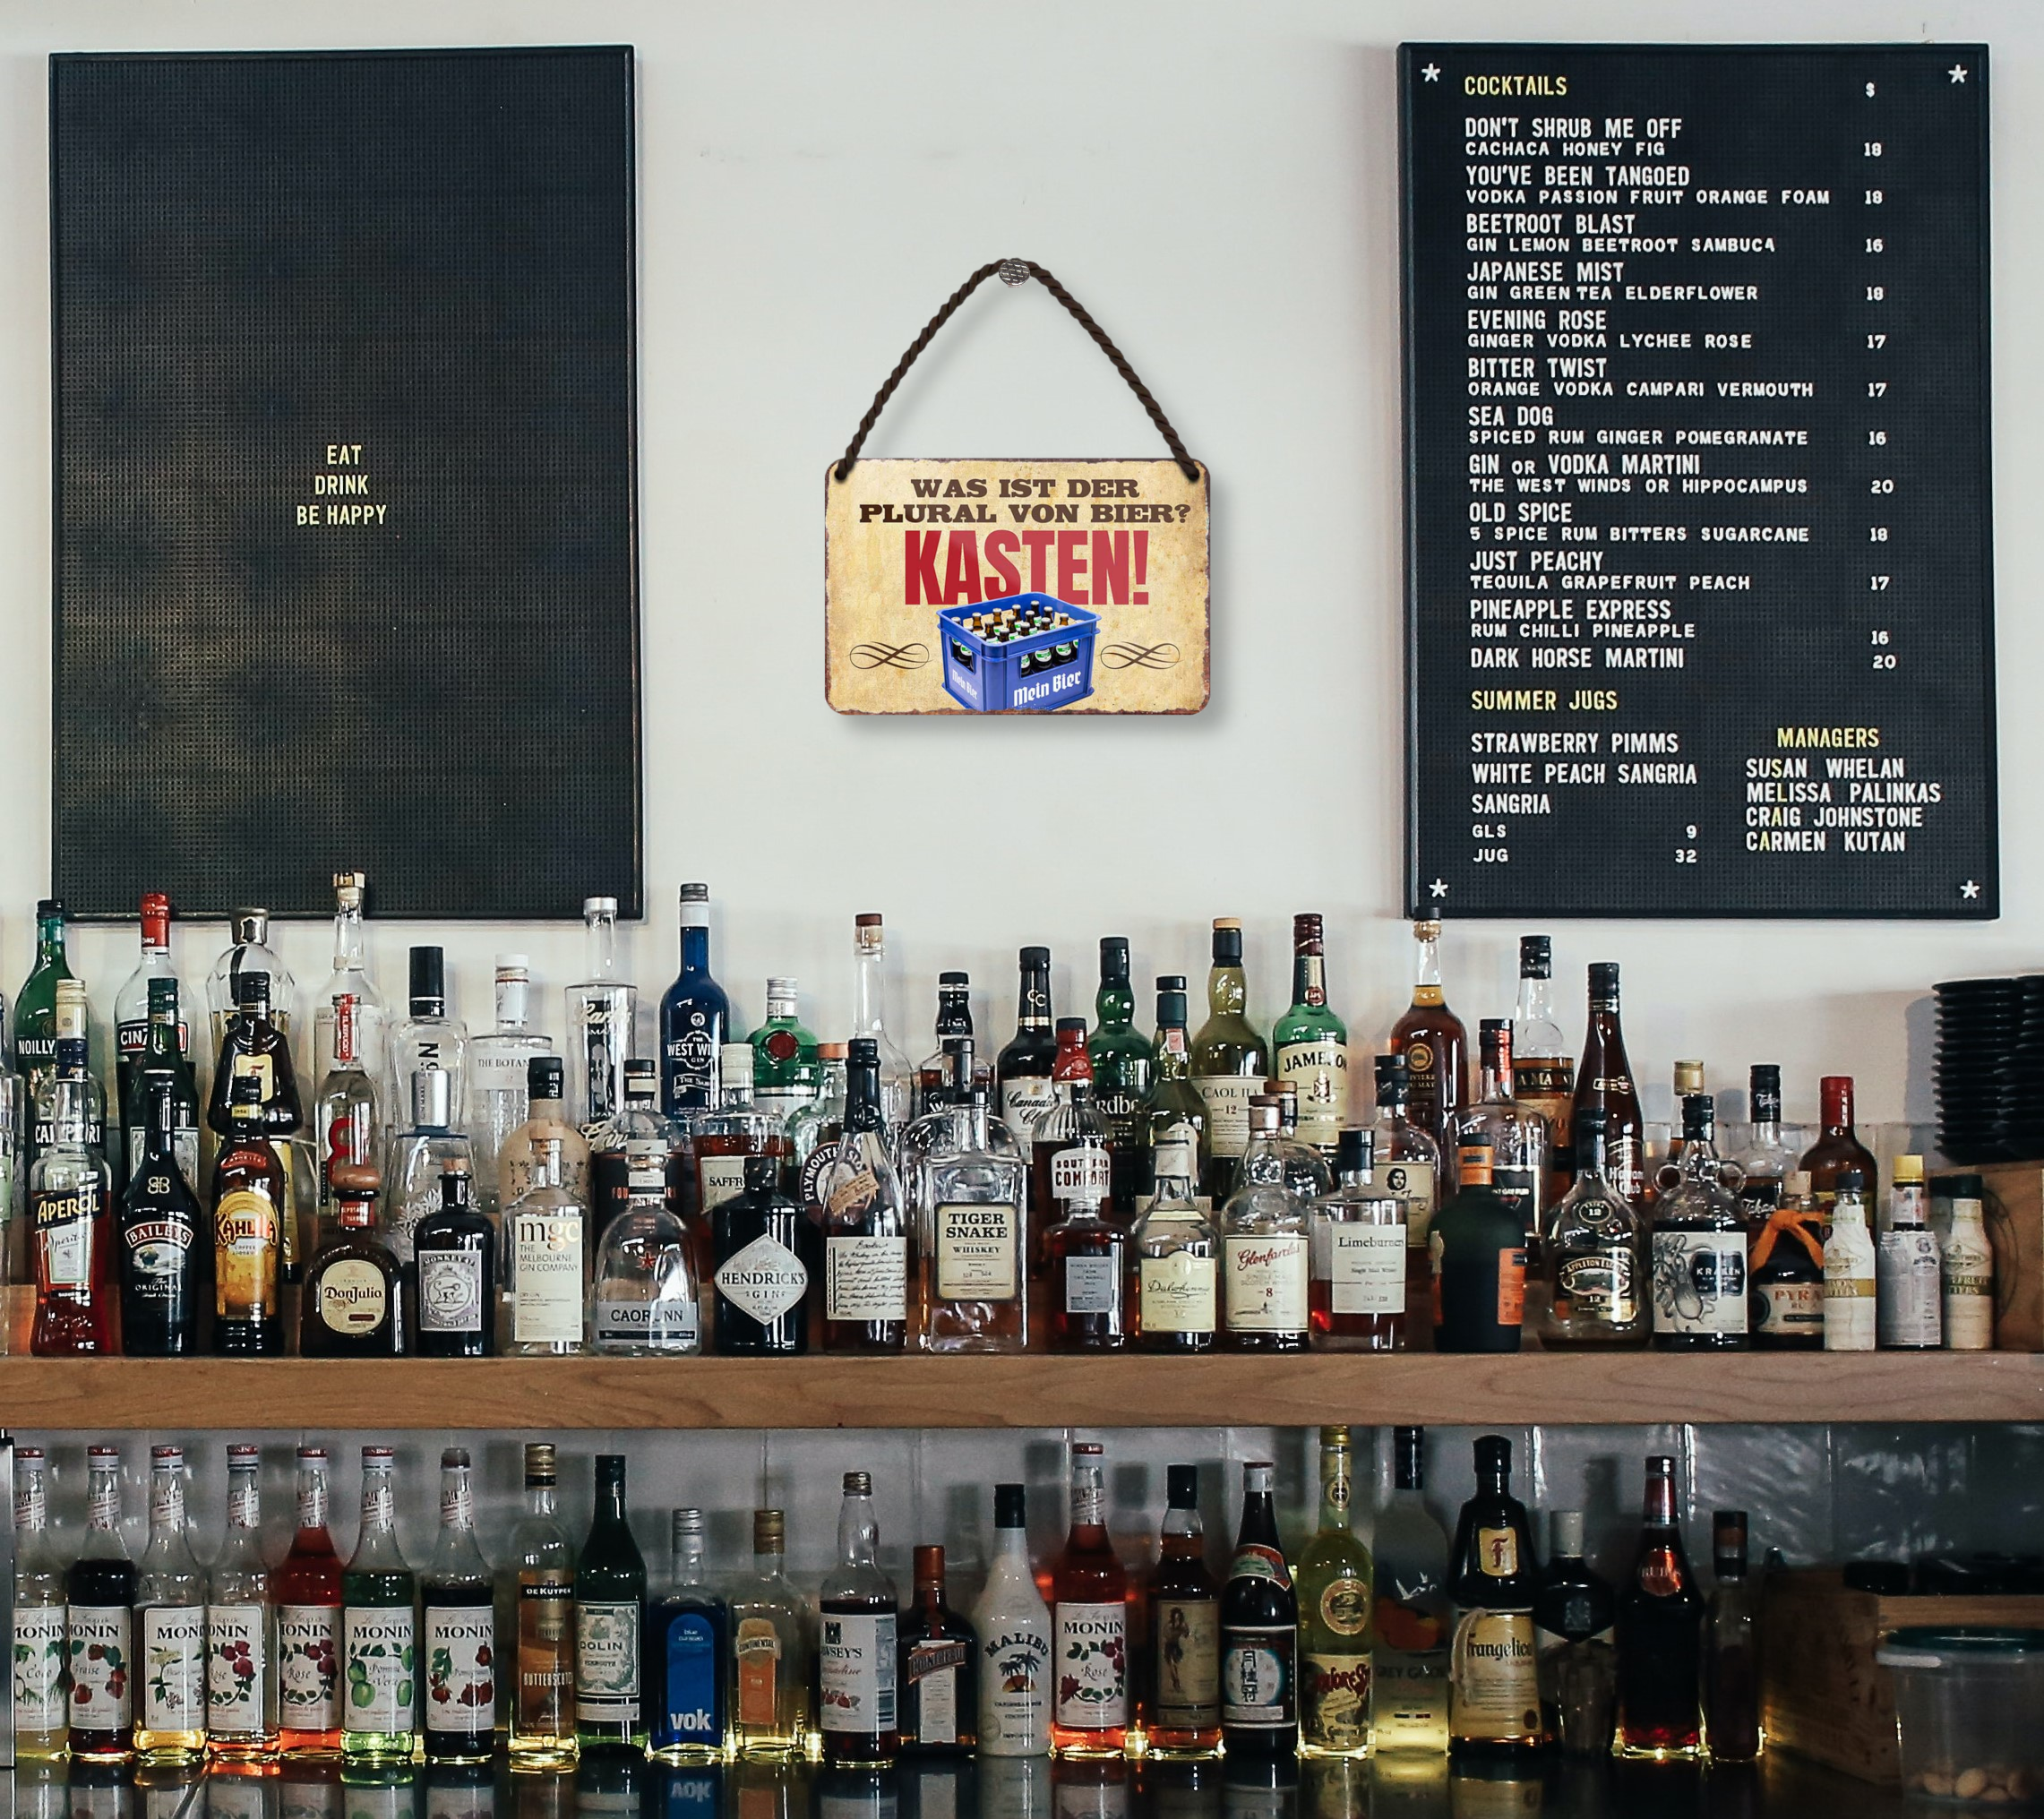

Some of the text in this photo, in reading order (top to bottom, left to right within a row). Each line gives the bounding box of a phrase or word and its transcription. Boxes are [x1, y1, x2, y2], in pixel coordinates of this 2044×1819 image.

[1464, 75, 1567, 96] COCKTAILS
[1865, 82, 1876, 99] $
[1464, 116, 1682, 139] DON'T SHRUB ME OFF
[1465, 141, 1665, 157] CACHACA HONEY FIG
[1864, 142, 1882, 158] 18
[1465, 164, 1690, 187] YOU'VE BEEN TANGOED
[1465, 189, 1830, 205] VODKA PASSION FRUIT ORANGE FOAM
[1865, 190, 1883, 205] 18
[1466, 213, 1636, 235] BEETROOT BLAST
[1466, 237, 1497, 253] GIN
[1509, 237, 1570, 253] LEMON
[1582, 237, 1679, 253] BEETROOT
[1865, 238, 1884, 253] 16
[1466, 261, 1624, 283] JAPANESE MIST
[1467, 285, 1758, 301] GIN GREEN TEA ELDERFLOWER
[1866, 286, 1884, 301] 18
[1467, 309, 1607, 331] EVENING ROSE
[1467, 333, 1752, 349] GINGER VODKA LYCHEE ROSE
[1867, 334, 1886, 349] 17
[1468, 357, 1607, 379] BITTER TWIST
[1467, 381, 1814, 398] ORANGE VODKA CAMPARI VERMOUTH
[1868, 382, 1887, 398] 17
[1468, 406, 1554, 426] SEA DOG
[1469, 429, 1808, 446] SPICED RUM GINGER POMEGRANATE
[1868, 431, 1886, 446] 16
[327, 444, 362, 466] EAT
[1469, 453, 1700, 476] GIN OR VODKA MARTINI
[314, 474, 369, 496] DRINK
[911, 478, 1140, 498] WAS IST DER
[1469, 477, 1808, 494] THE WEST WINDS OR HIPPOCAMPUS
[1870, 479, 1894, 494] 20
[296, 504, 387, 526] BE HAPPY
[859, 503, 1191, 523] PLURAL VON BIER?
[1469, 502, 1573, 523] OLD SPICE
[1469, 526, 1809, 543] 5 SPICE RUM BITTERS SUGARCANE
[1870, 527, 1888, 542] 18
[904, 528, 1149, 605] KASTEN!
[1469, 550, 1603, 571] JUST PEACHY
[1470, 574, 1750, 590] TEQUILA GRAPEFRUIT PEACH
[1870, 576, 1890, 591] 17
[1470, 598, 1671, 621] PINEAPPLE EXPRESS
[1471, 622, 1696, 639] RUM CHILLI PINEAPPLE
[1870, 630, 1889, 646] 16
[1471, 647, 1684, 669] DARK HORSE MARTINI
[1872, 654, 1897, 670] 20
[1013, 670, 1082, 708] Mein Bier
[1471, 690, 1618, 711] SUMMER JUGS
[1471, 732, 1679, 754] STRAWBERRY PIMMS
[1777, 727, 1880, 749] MANAGERS
[1472, 762, 1697, 785] WHITE PEACH SANGRIA
[1746, 757, 1904, 779] SUSAN WHELAN
[1747, 782, 1942, 803] MELISSA PALINKAS
[1472, 793, 1551, 815] SANGRIA
[1746, 806, 1923, 828] CRAIG JOHNSTONE
[1472, 824, 1507, 838] GLS
[1686, 824, 1697, 839] 9
[1746, 830, 1906, 853] CARMEN KUTAN
[1473, 847, 1508, 862] JUG
[1675, 848, 1697, 863] 32
[18, 1039, 56, 1055] NOILLY
[666, 1042, 694, 1057] WEST
[477, 1059, 494, 1068] THE
[1202, 1086, 1237, 1099] CAOL
[1224, 1104, 1238, 1115] 12
[38, 1194, 100, 1224] APEROL
[948, 1212, 1005, 1226] TIGER
[520, 1221, 580, 1252] mgc
[946, 1227, 1008, 1240] SNAKE
[520, 1243, 536, 1253] THE
[952, 1245, 1001, 1254] WHISKEY
[520, 1254, 571, 1263] MELBOURNE
[520, 1264, 579, 1273] GIN COMPANY
[721, 1272, 806, 1286] HENDRICK'S
[751, 1290, 781, 1300] GIN
[1265, 1287, 1274, 1297] 8
[610, 1309, 683, 1322] CAORNN
[353, 1625, 413, 1639] MONIN
[435, 1625, 494, 1639] MONIN
[1063, 1620, 1123, 1635] MONIN
[580, 1640, 623, 1652] DOLIN
[984, 1632, 1051, 1658] MALIBU
[286, 1668, 311, 1681] Rose
[670, 1708, 712, 1731] vok
